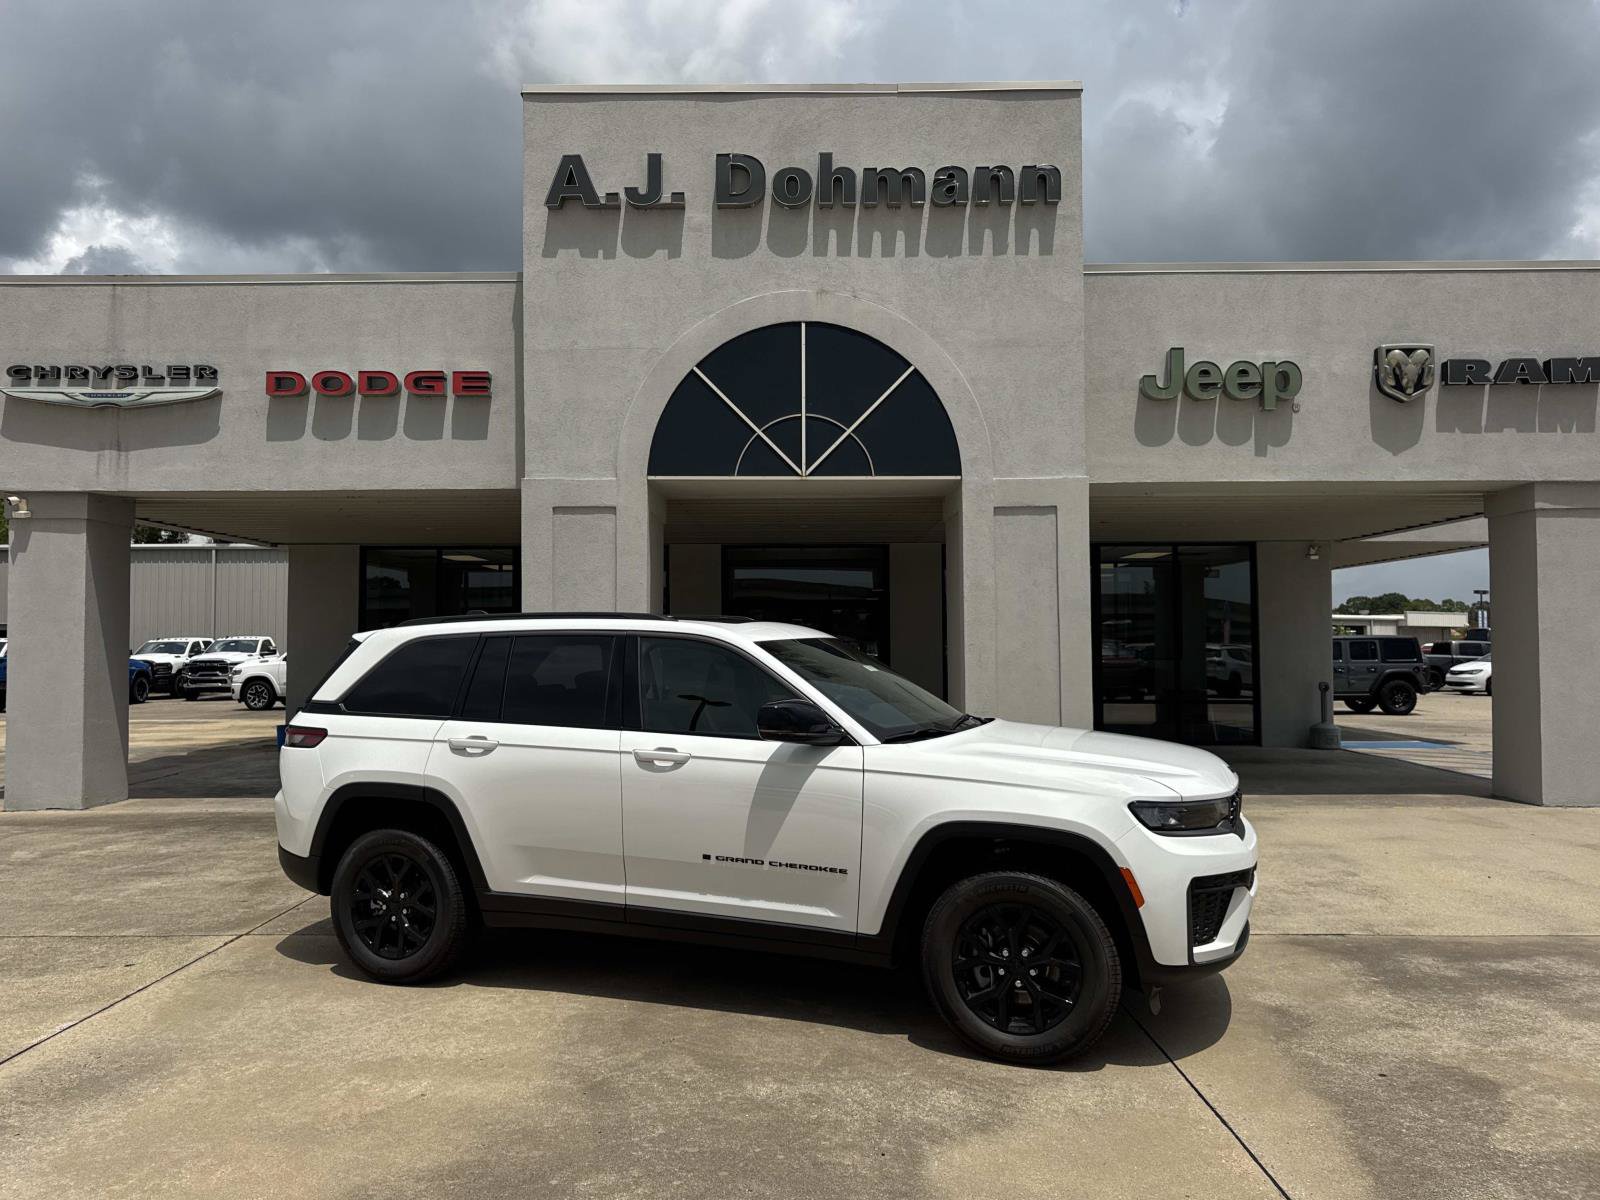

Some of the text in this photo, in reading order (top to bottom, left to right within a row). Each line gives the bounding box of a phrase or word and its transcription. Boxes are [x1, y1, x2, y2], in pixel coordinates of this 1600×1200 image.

[544, 151, 1062, 208] A.J. Dohmann
[6, 364, 218, 381] CHRYSLER
[266, 370, 491, 397] DODGE
[1140, 347, 1303, 411] Jeep
[1442, 357, 1600, 384] RAM
[715, 855, 849, 875] GRAND CHEROKEE
